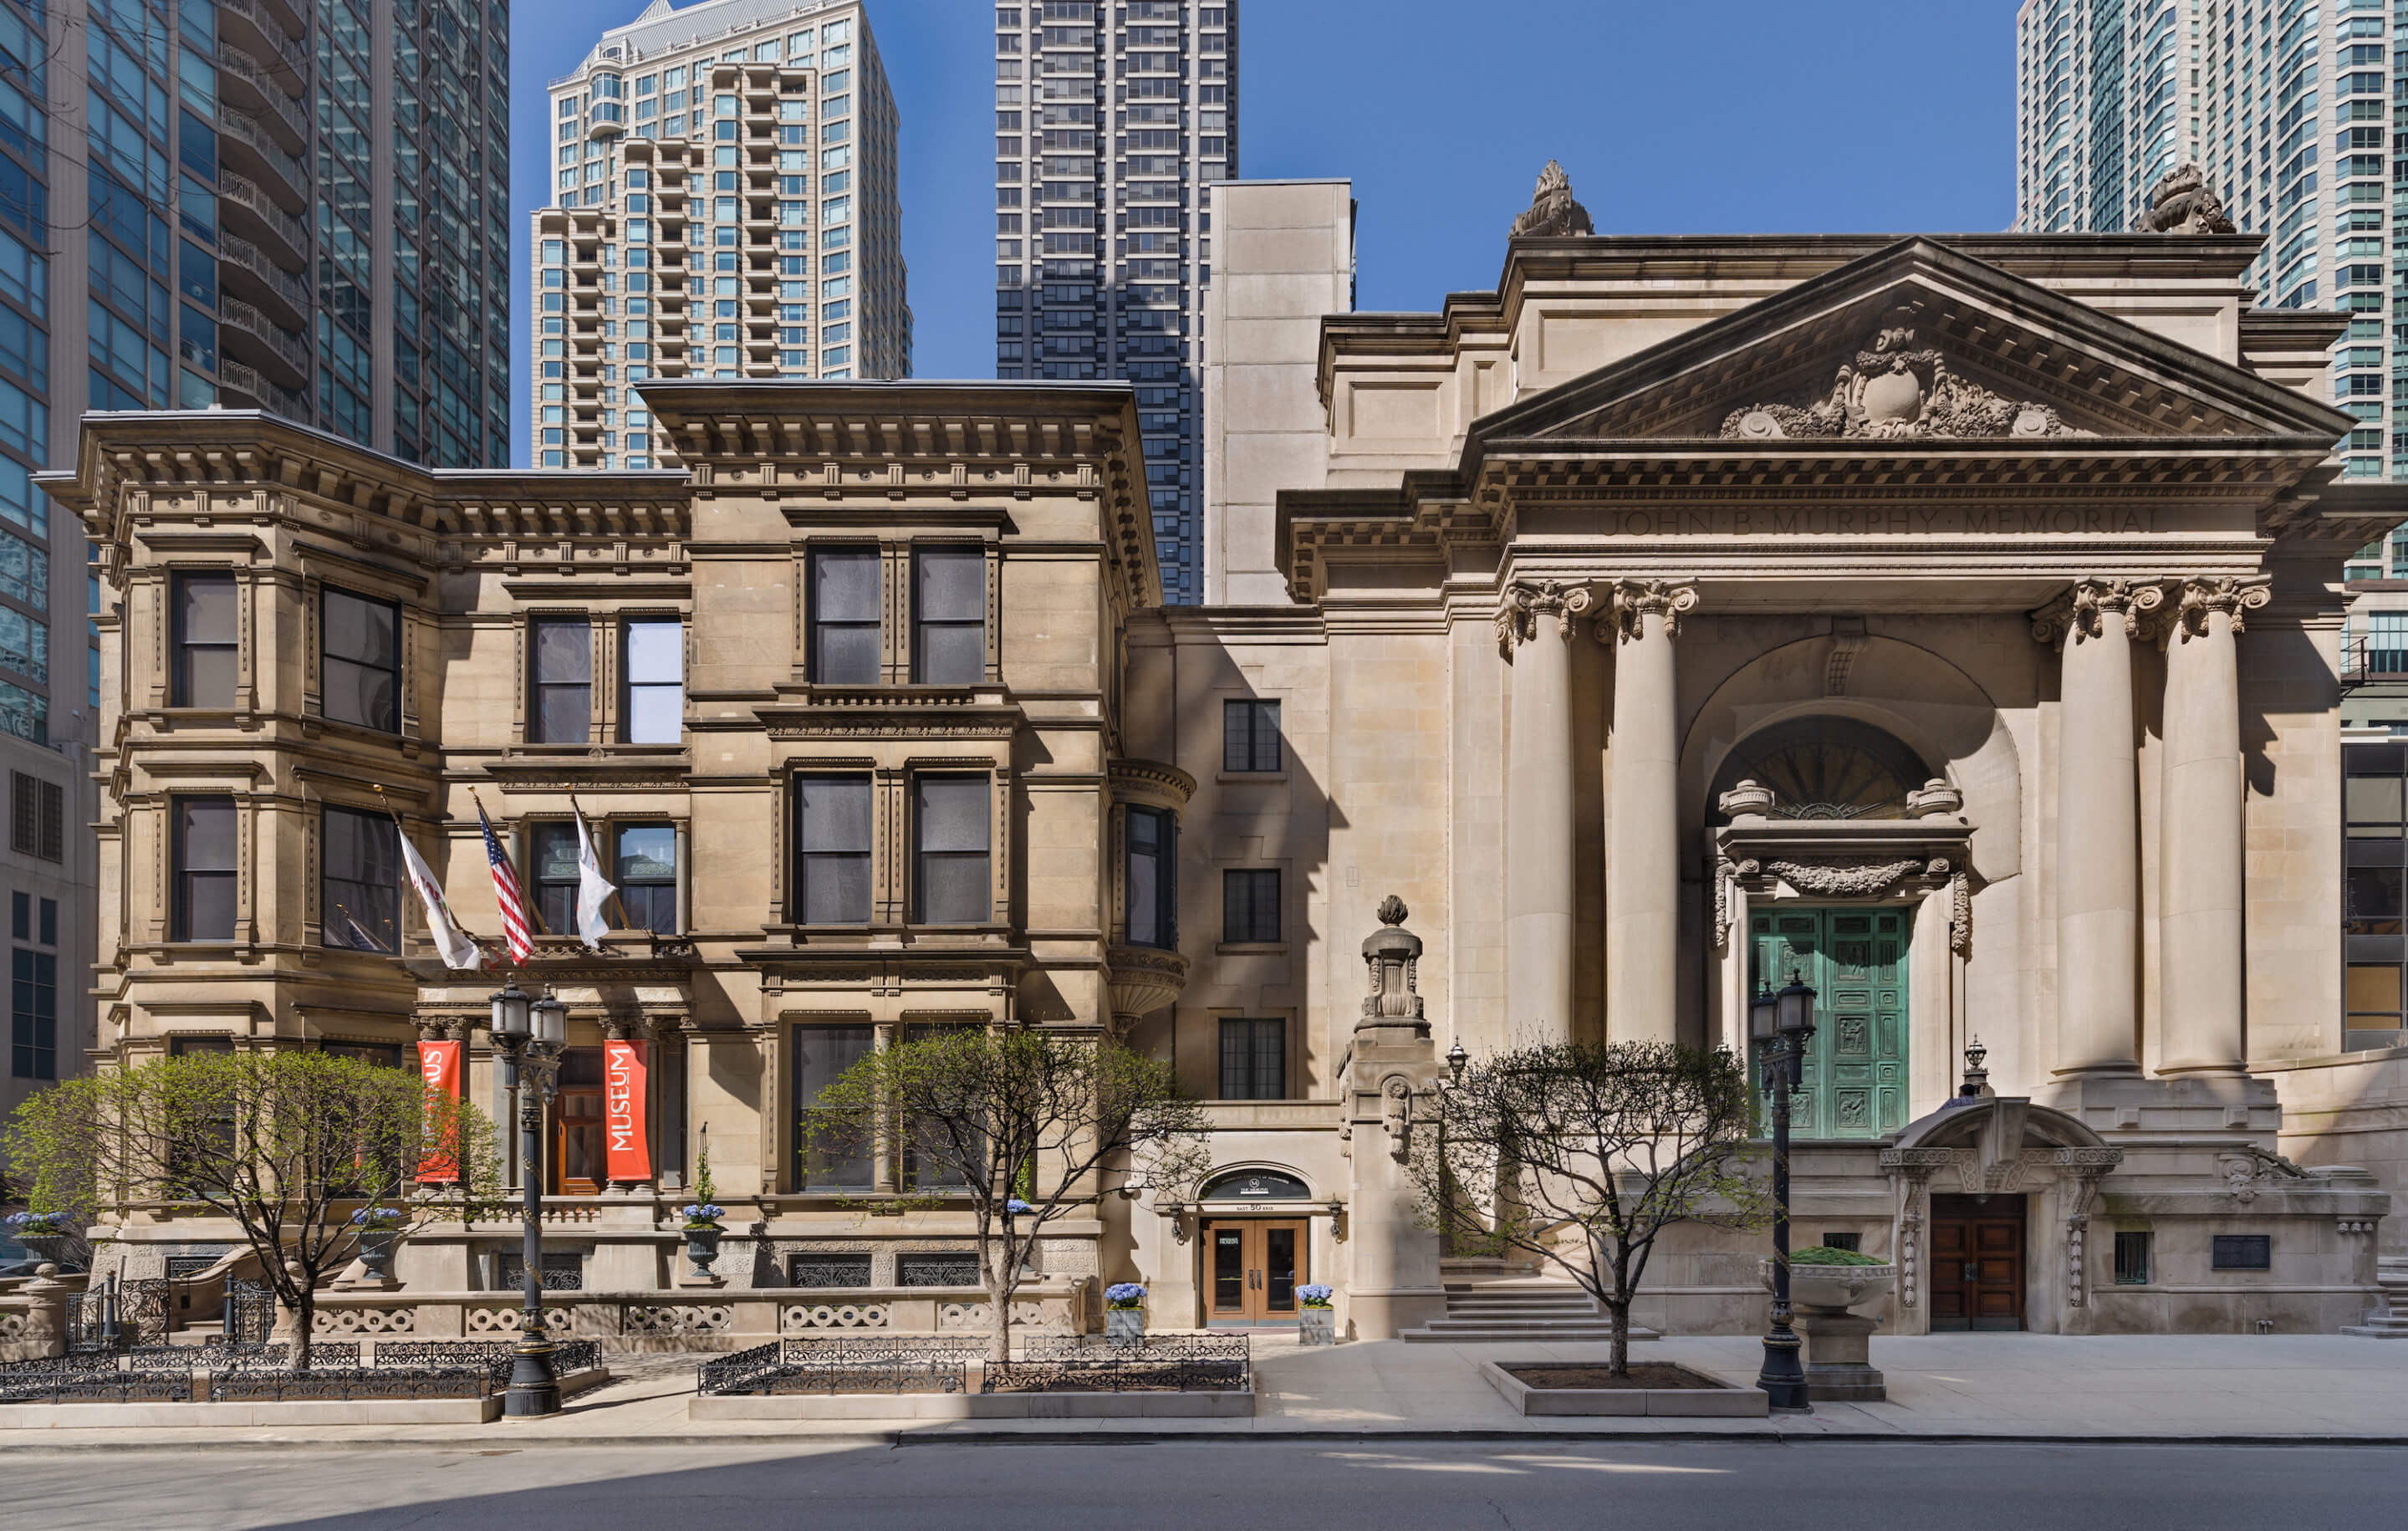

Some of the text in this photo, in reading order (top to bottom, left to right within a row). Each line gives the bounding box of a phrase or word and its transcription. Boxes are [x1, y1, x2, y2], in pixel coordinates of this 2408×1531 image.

[1598, 508, 2167, 535] JOHN B MURPHY MEMORIAL
[610, 1048, 634, 1151] MUSEUM
